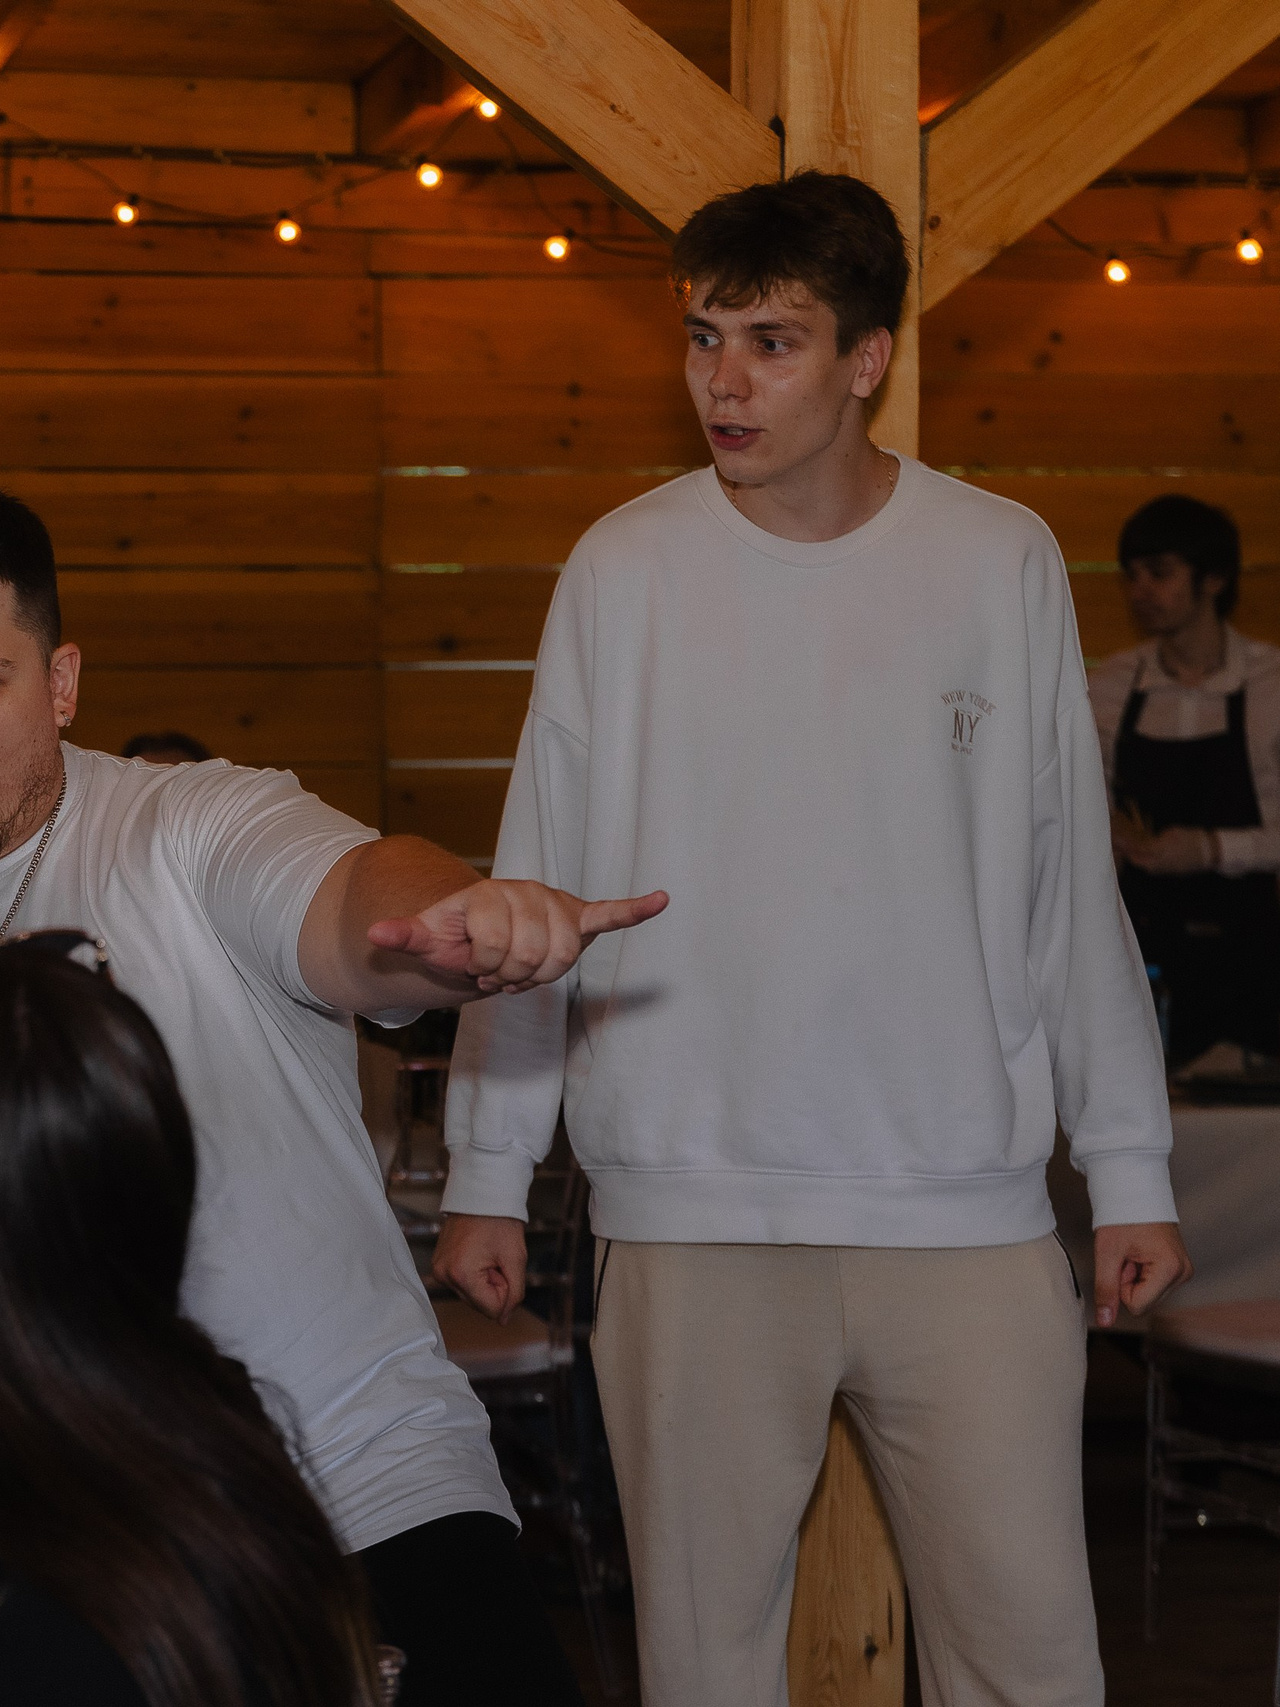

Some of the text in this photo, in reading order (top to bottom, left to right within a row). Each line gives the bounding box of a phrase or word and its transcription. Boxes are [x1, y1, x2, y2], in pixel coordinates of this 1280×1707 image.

[941, 690, 997, 716] NEW YORK
[952, 707, 981, 743] NY
